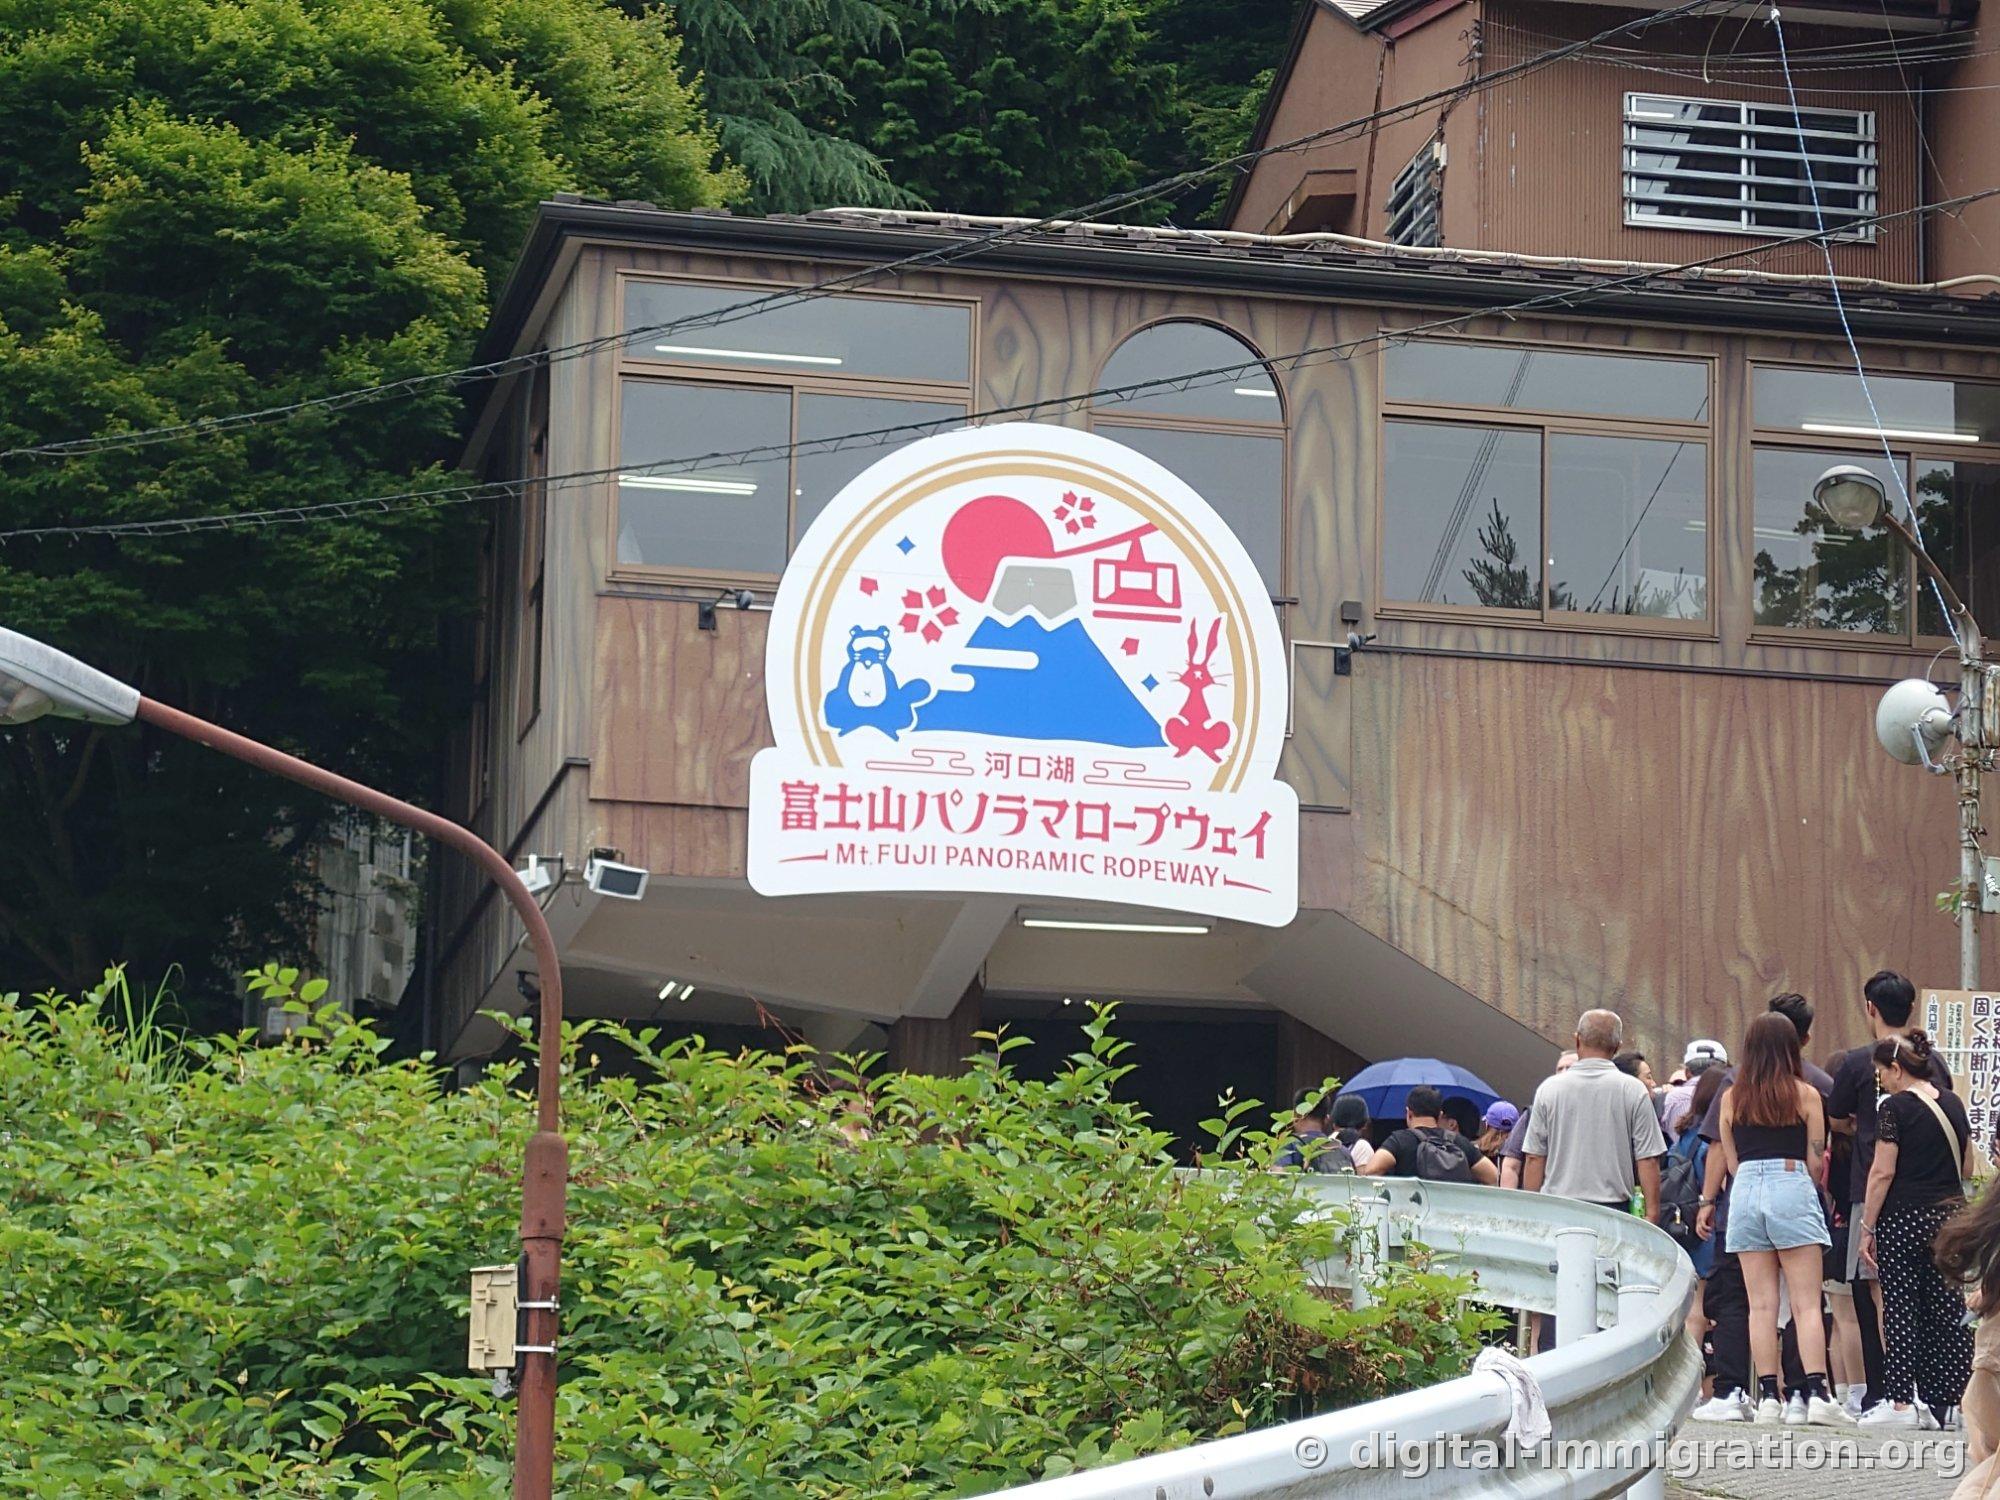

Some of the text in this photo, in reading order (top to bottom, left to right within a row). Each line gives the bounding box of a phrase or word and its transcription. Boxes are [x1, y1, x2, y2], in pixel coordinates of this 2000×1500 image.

[984, 751, 1075, 783] 河口湖
[780, 780, 1273, 860] 富士山パノラマロープウェイ
[945, 846, 1094, 875] PANORAMIC
[1103, 855, 1219, 887] ROPEWAY
